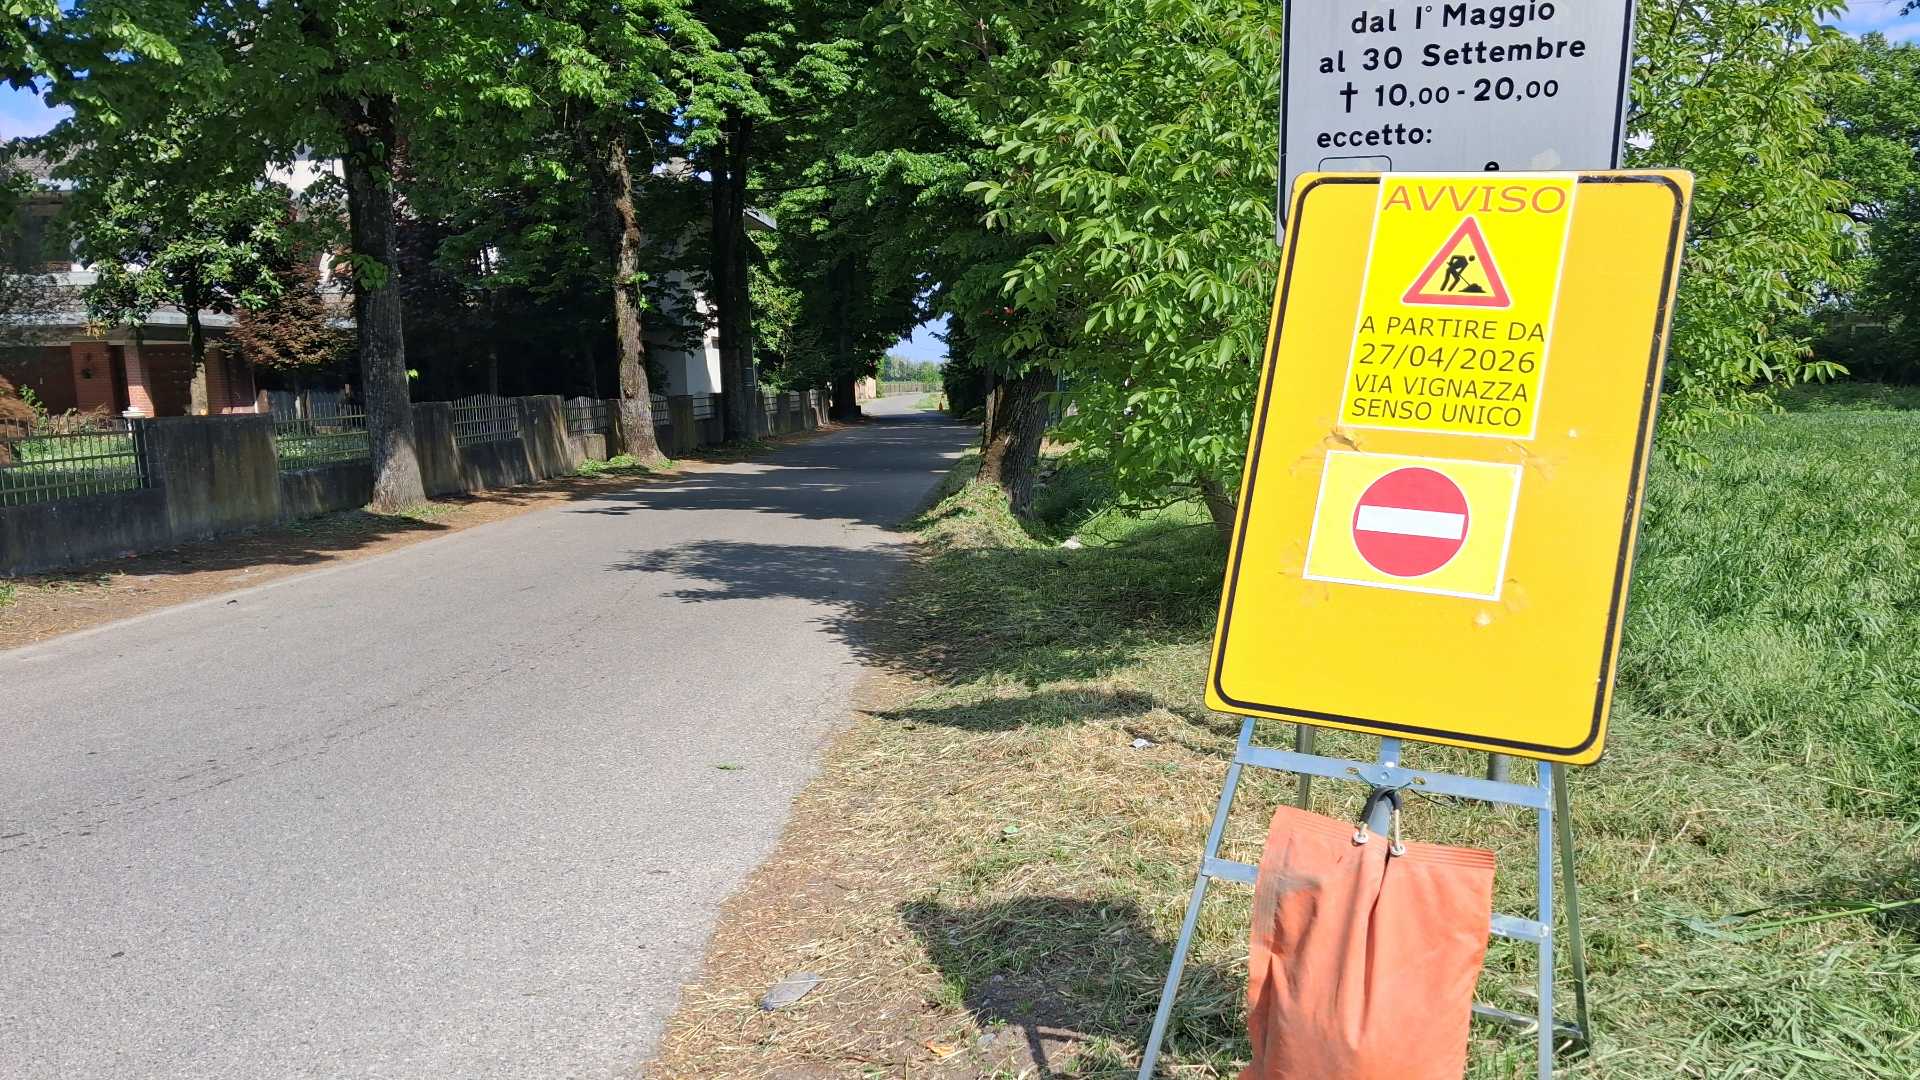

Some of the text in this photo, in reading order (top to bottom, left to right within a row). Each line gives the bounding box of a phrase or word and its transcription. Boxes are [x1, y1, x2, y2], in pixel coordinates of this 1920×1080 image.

[1351, 9, 1396, 34] dal
[1442, 0, 1555, 29] Maggio
[1319, 37, 1586, 74] al 30 Settembre
[1316, 123, 1433, 148] eccetto:
[1383, 186, 1567, 214] AVVISO
[1359, 315, 1545, 342] A PARTIRE DA
[1359, 343, 1536, 374] 27/04/2026
[1355, 374, 1528, 403] VIA VIGNAZZA
[1351, 398, 1522, 427] SENSO UNICO
